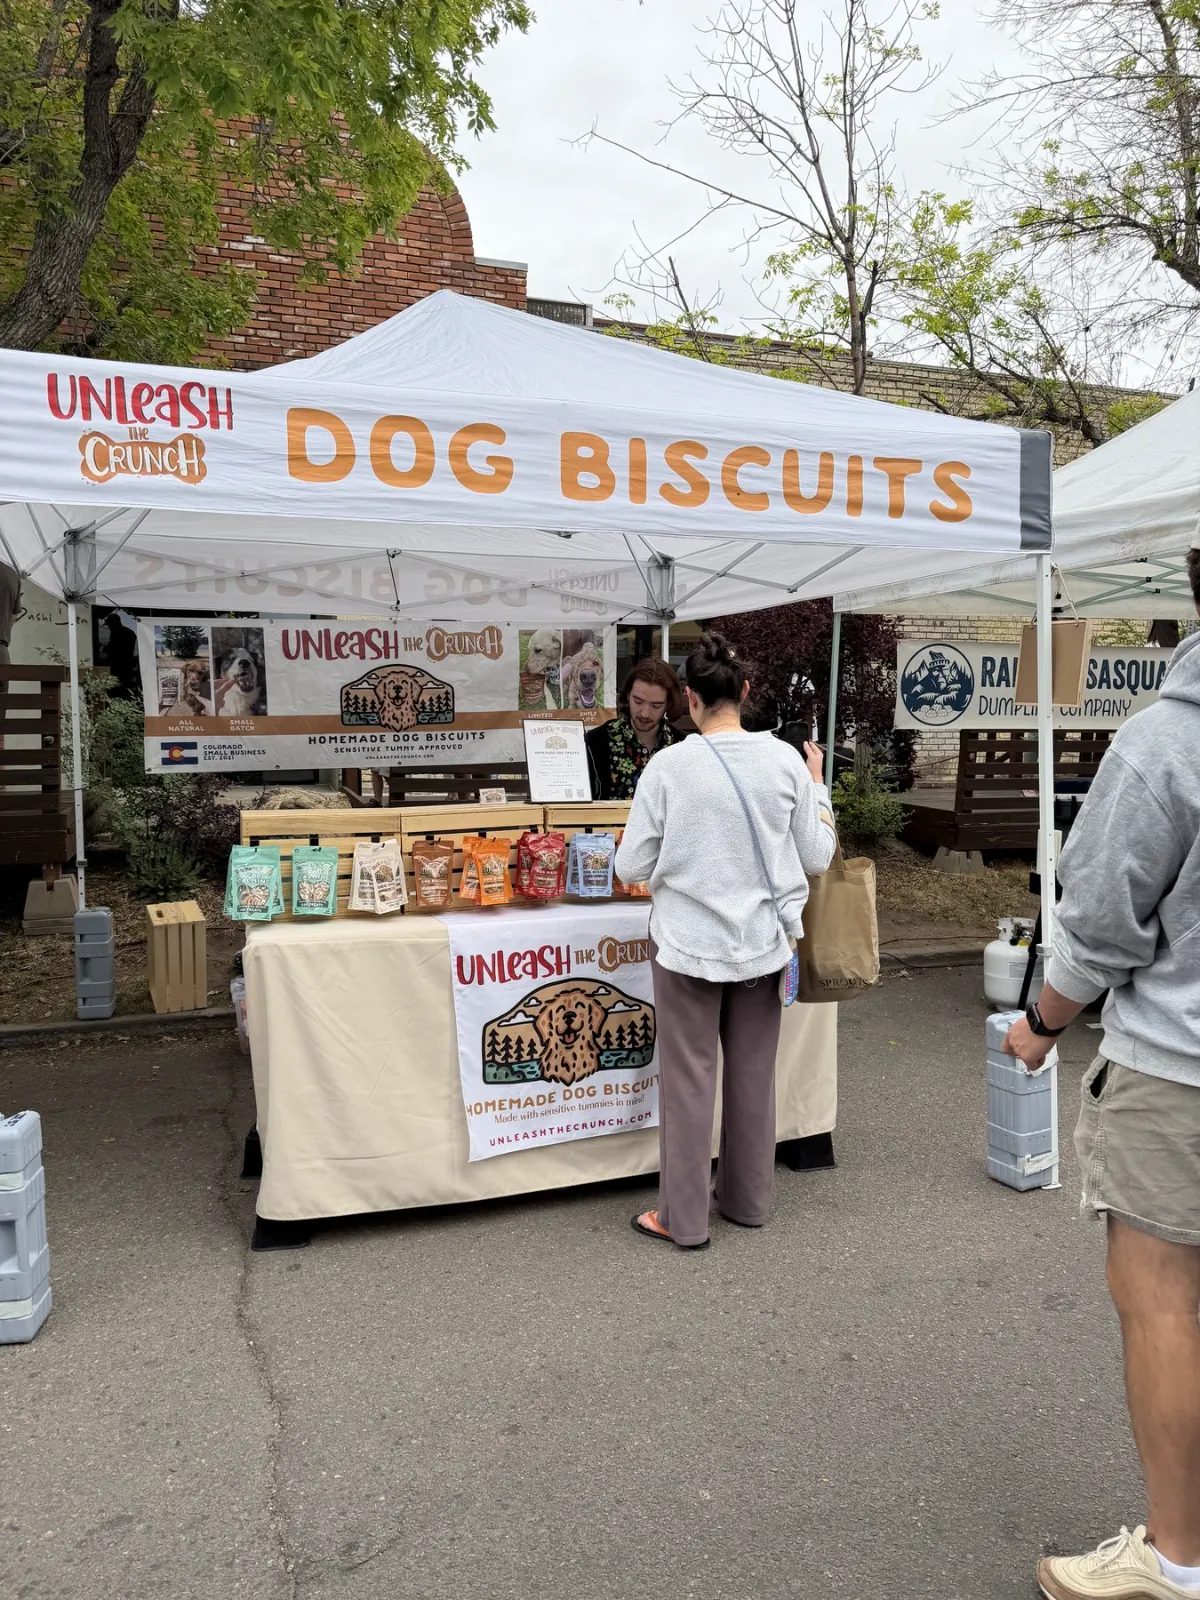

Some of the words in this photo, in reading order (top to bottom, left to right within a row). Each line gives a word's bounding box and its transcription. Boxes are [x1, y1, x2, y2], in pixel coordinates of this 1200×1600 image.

[87, 431, 201, 477] CRUNCH
[287, 408, 514, 494] DOG
[560, 432, 973, 522] BISCUITS
[430, 626, 501, 658] CRUNCH
[1086, 658, 1168, 695] SASQUA
[308, 734, 386, 745] HOMEMADE
[392, 733, 420, 742] DOG
[426, 731, 486, 741] BISCUITS
[334, 745, 382, 754] SENSITIVE
[385, 744, 415, 752] TUMMY
[418, 743, 463, 751] APPROVED
[601, 940, 649, 968] CRUN
[819, 978, 868, 988] SPROUTS
[466, 1092, 556, 1117] HOMEMADE
[563, 1085, 597, 1101] DOG
[603, 1074, 660, 1096] BISCUIT
[495, 1111, 518, 1124] Made
[520, 1109, 539, 1121] with
[540, 1103, 576, 1118] sensitive
[578, 1098, 615, 1112] tummies
[616, 1097, 625, 1107] in
[626, 1094, 645, 1106] mind
[489, 1111, 652, 1147] UNLEASHTHECRUNCH.COM
